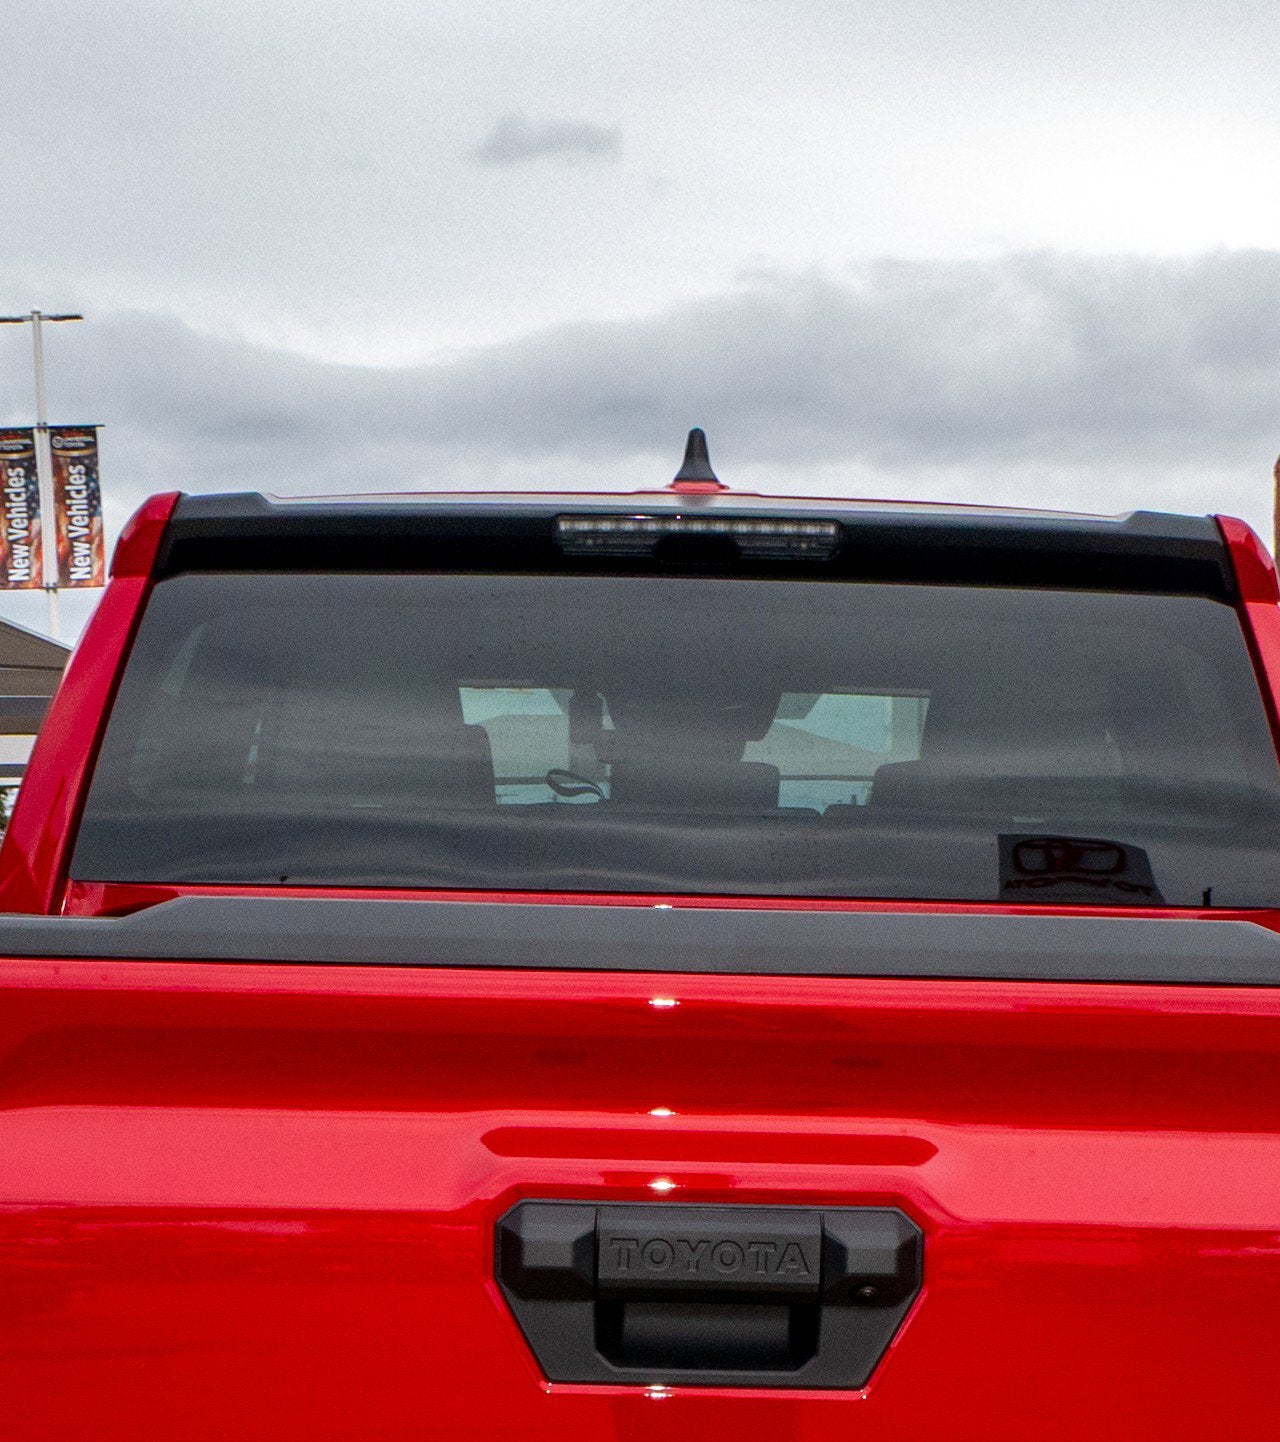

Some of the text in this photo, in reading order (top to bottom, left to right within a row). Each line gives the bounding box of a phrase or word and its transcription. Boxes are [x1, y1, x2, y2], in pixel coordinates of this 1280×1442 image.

[5, 468, 30, 582] New Vehicles
[65, 464, 90, 538] Vehicles
[70, 541, 91, 580] New
[609, 1237, 811, 1276] TOYOTA
